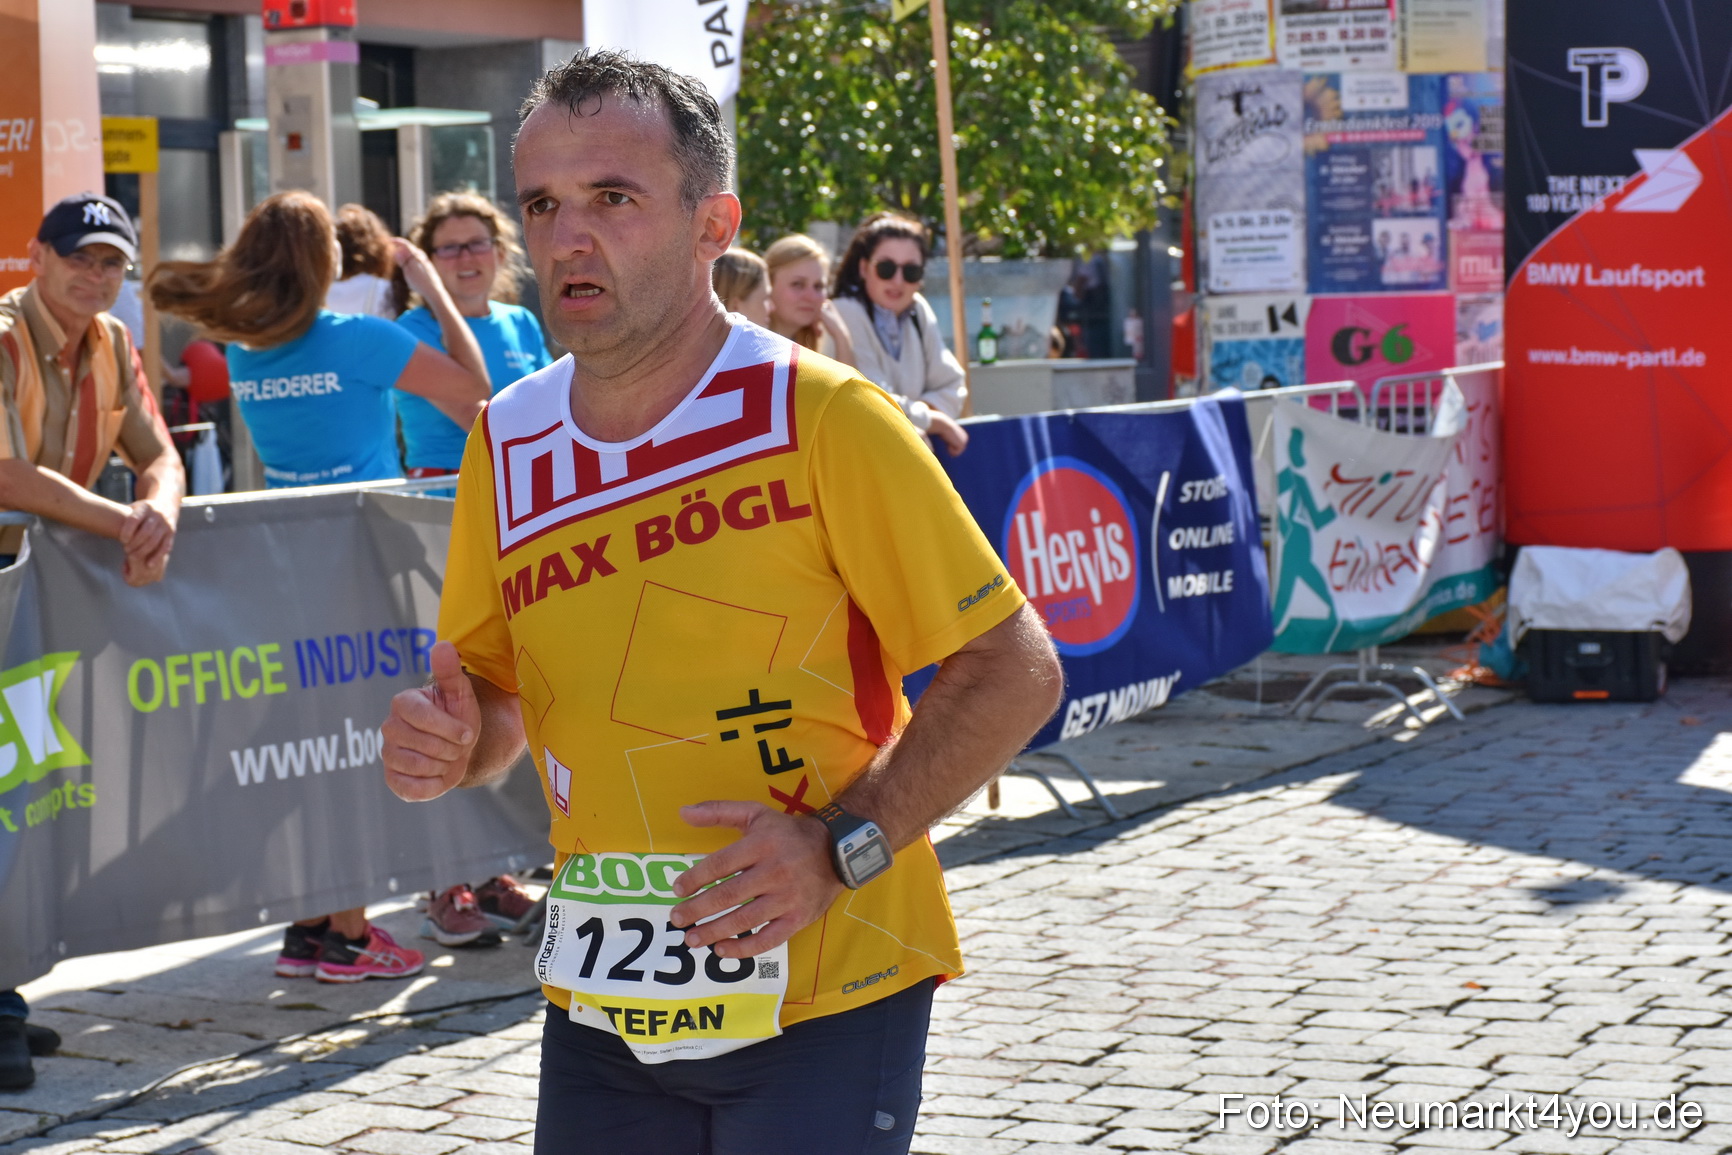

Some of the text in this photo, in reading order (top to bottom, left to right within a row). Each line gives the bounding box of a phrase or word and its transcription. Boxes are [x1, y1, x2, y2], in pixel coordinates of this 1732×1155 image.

[697, 0, 735, 68] PA
[0, 118, 34, 152] ER!
[102, 128, 147, 143] ummern-
[1547, 176, 1628, 193] THE NEXT
[1527, 195, 1606, 212] 100 YEARS
[1526, 262, 1706, 290] BMW Laufsport
[236, 371, 342, 401] PFLEIDERER
[1179, 475, 1228, 504] STORE
[501, 478, 812, 622] MAX BÖGL
[1168, 522, 1235, 550] ONLINE
[1015, 508, 1131, 604] Hervis
[1167, 570, 1234, 599] MOBILE
[1045, 601, 1093, 625] SPORTS
[127, 627, 436, 713] OFFICE INDUSTR
[1061, 690, 1108, 741] GET
[564, 853, 702, 894] BOC
[601, 1004, 725, 1036] TEFAN
